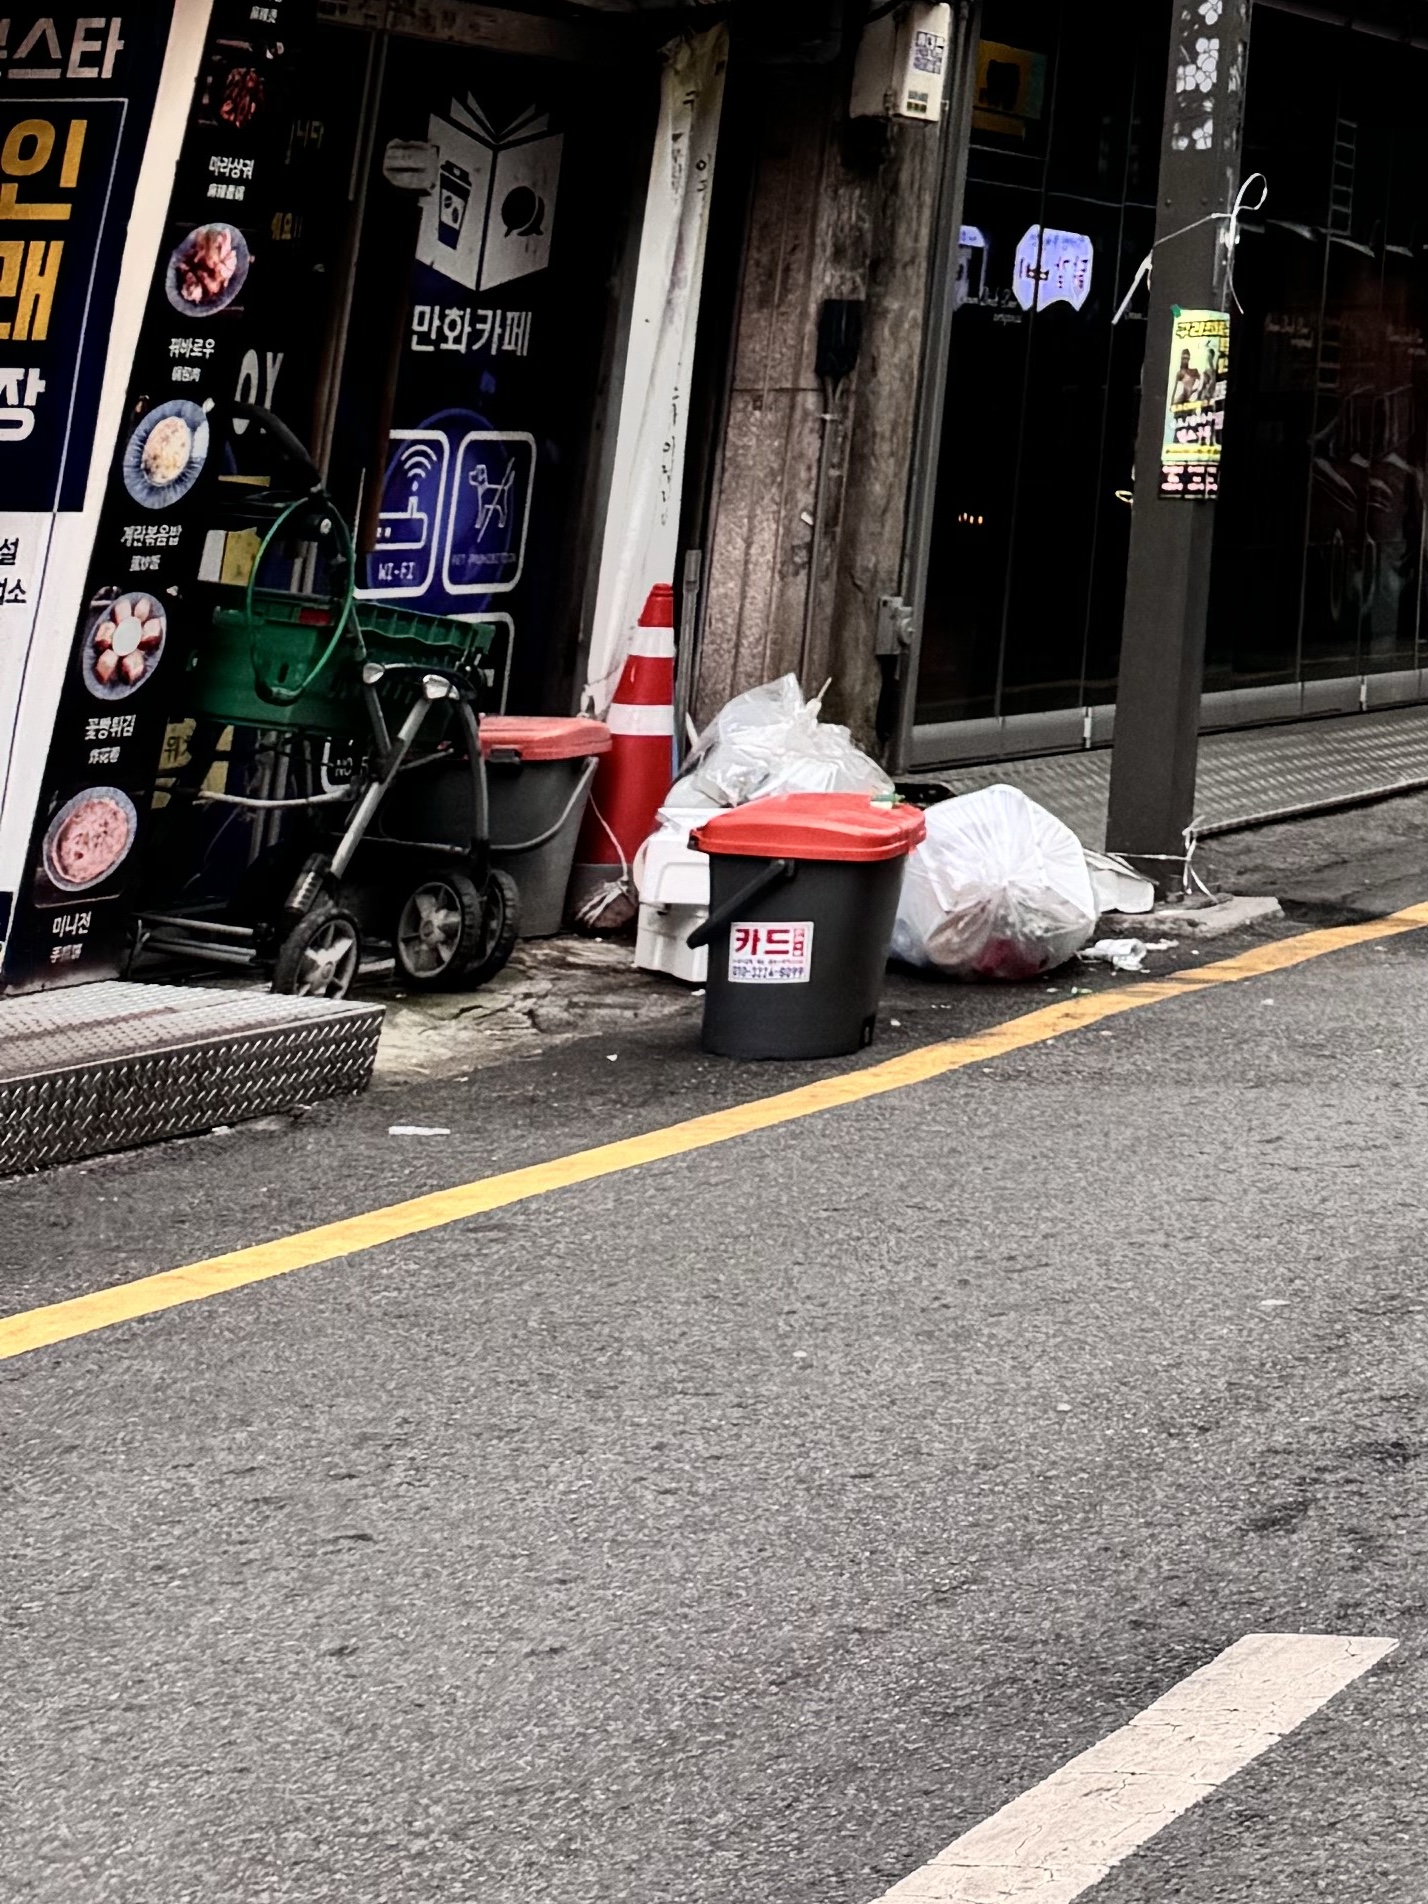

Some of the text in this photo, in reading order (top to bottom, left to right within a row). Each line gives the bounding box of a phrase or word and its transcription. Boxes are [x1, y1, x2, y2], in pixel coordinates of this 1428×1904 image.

[0, 17, 125, 80] 스타
[411, 305, 532, 357] 만화카페
[735, 928, 790, 956] 카드
